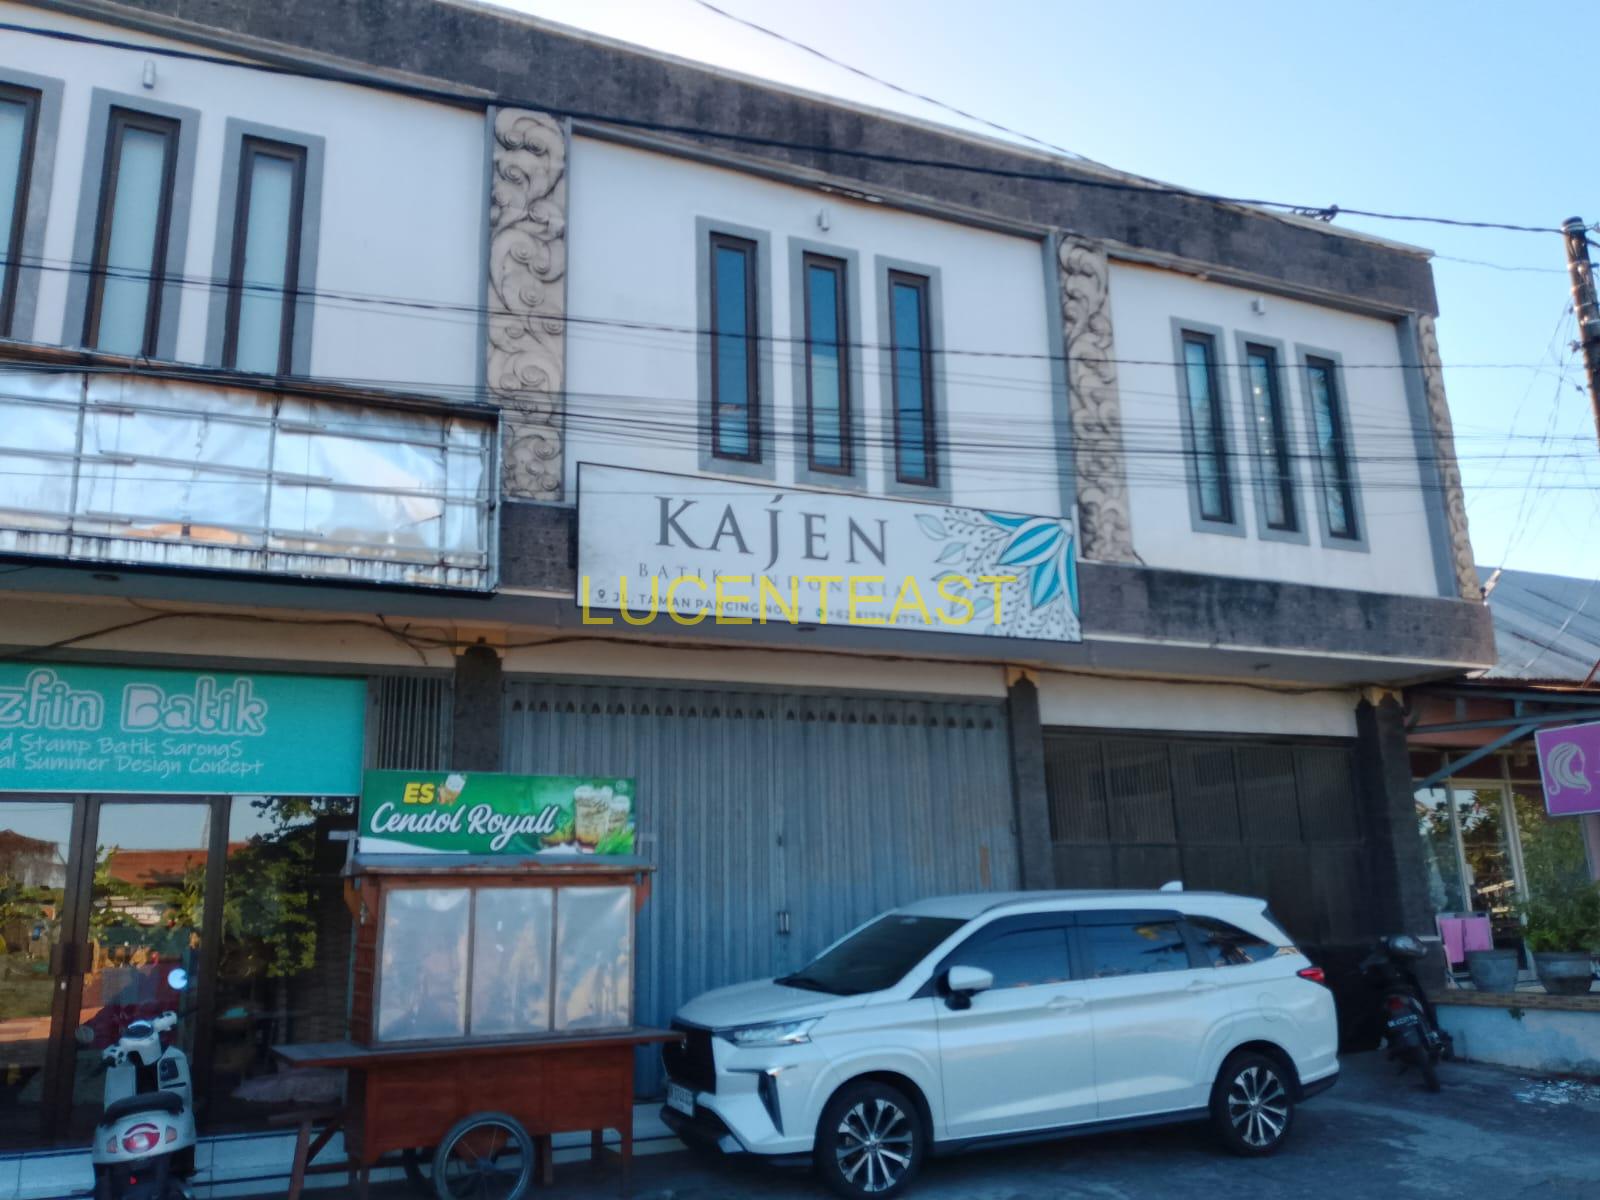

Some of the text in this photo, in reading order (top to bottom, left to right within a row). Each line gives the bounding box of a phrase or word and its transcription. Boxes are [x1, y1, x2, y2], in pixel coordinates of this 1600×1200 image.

[639, 562, 906, 599] BATIK INDONESIA
[639, 593, 690, 608] TAMAN
[695, 598, 759, 613] PANCING
[120, 674, 268, 736] Batik
[20, 733, 91, 757] Stamp
[97, 736, 156, 756] Batik
[24, 751, 108, 771] Summer
[116, 755, 181, 779] Design
[189, 758, 264, 778] Concept
[402, 782, 436, 804] ES
[370, 801, 560, 851] Cendol Royall
